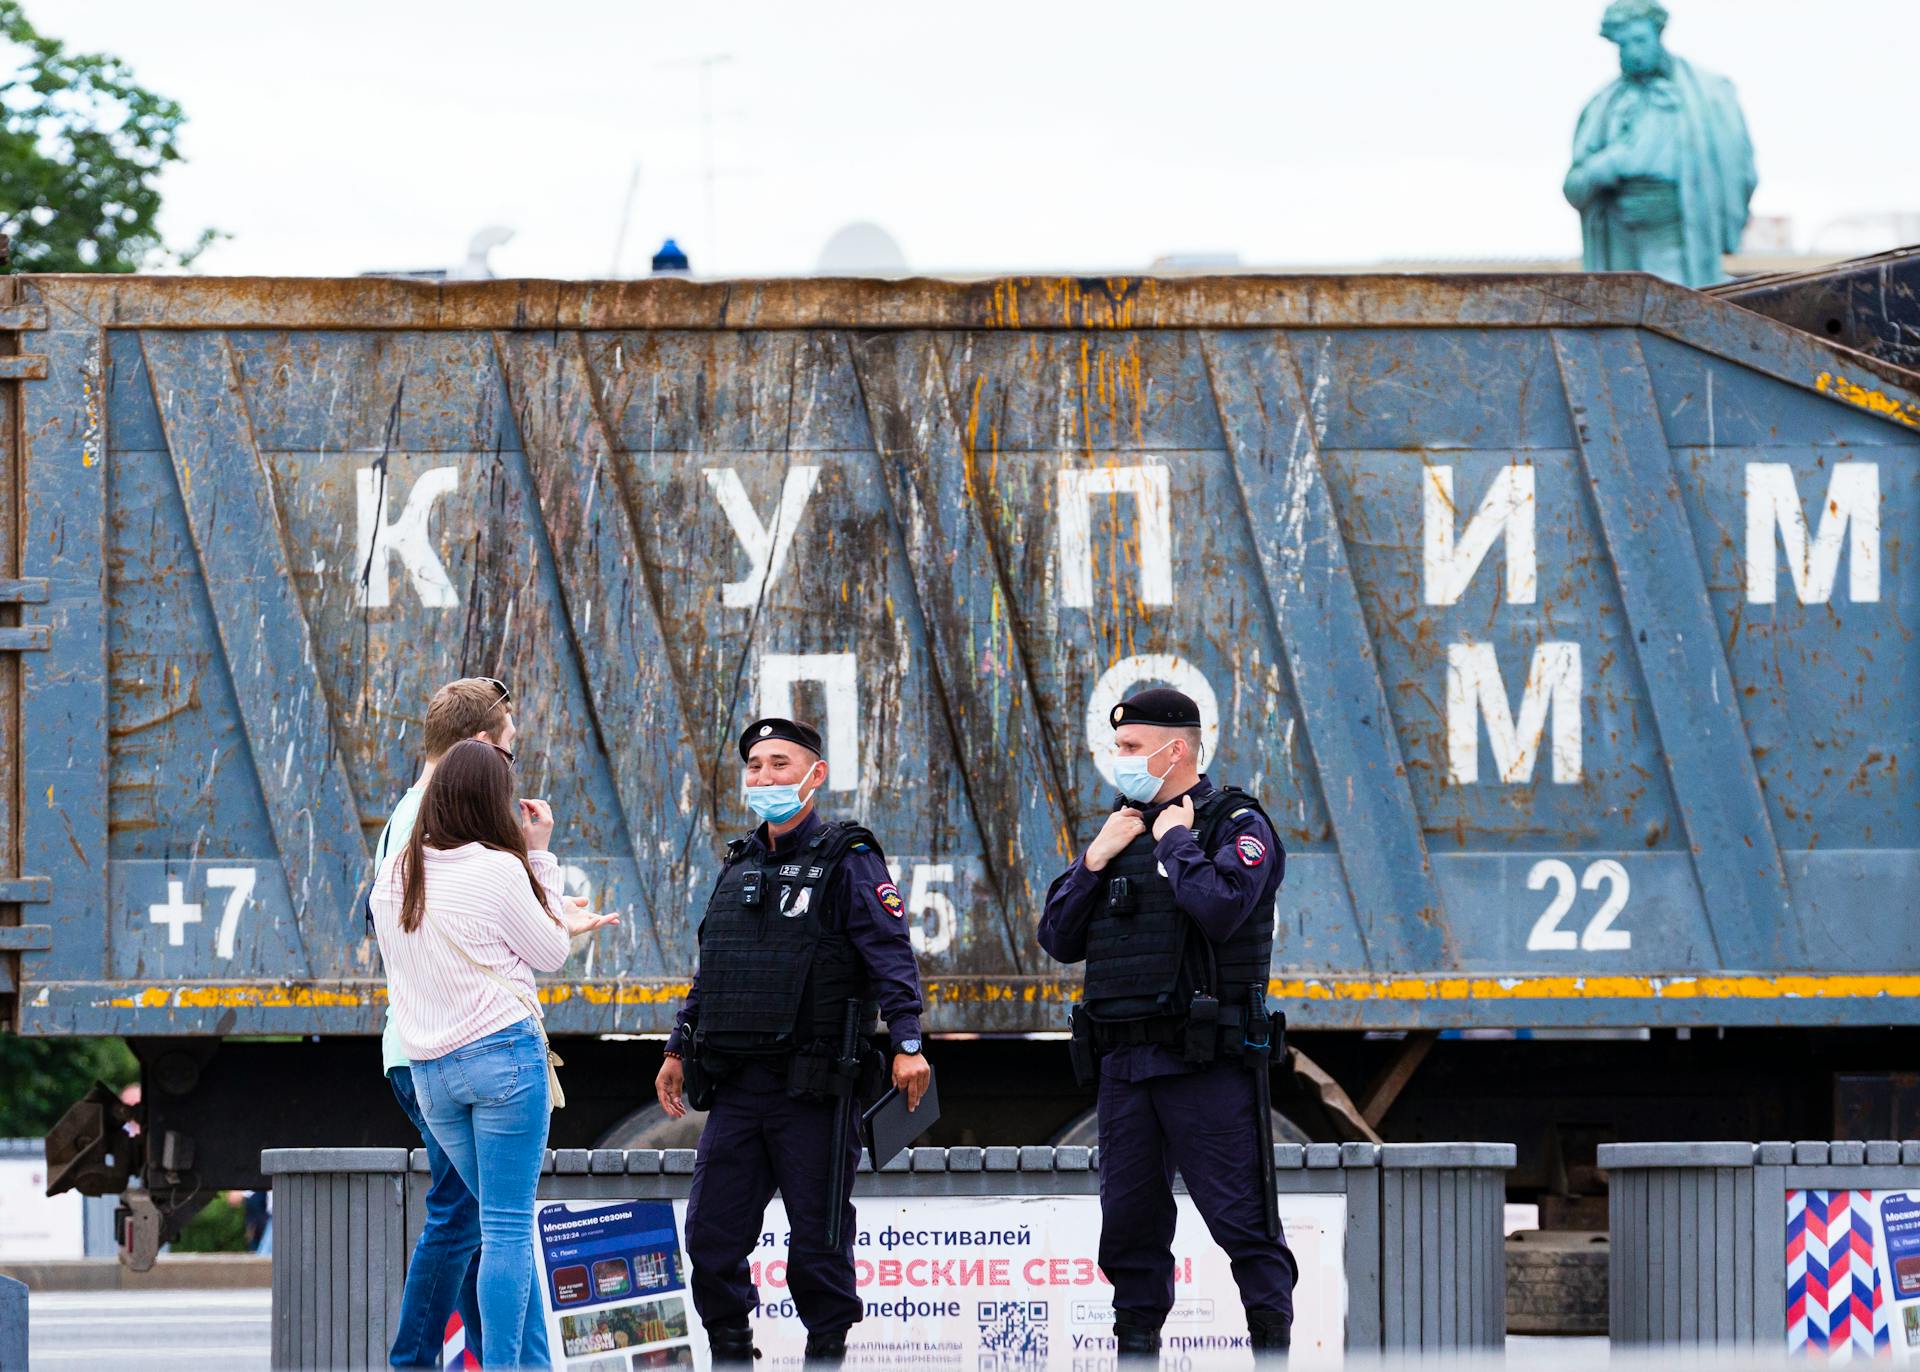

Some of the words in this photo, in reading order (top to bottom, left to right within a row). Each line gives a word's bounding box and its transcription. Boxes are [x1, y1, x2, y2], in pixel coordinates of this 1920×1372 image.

[356, 462, 1881, 607] КУПИМ
[149, 868, 256, 960] +7
[1526, 859, 1631, 951] 22
[543, 1217, 598, 1233] Московские
[599, 1211, 632, 1223] сезоны
[879, 1225, 1031, 1250] фестивалей
[751, 1259, 1011, 1287] ООВСКИЕ
[865, 1297, 961, 1321] лефоне
